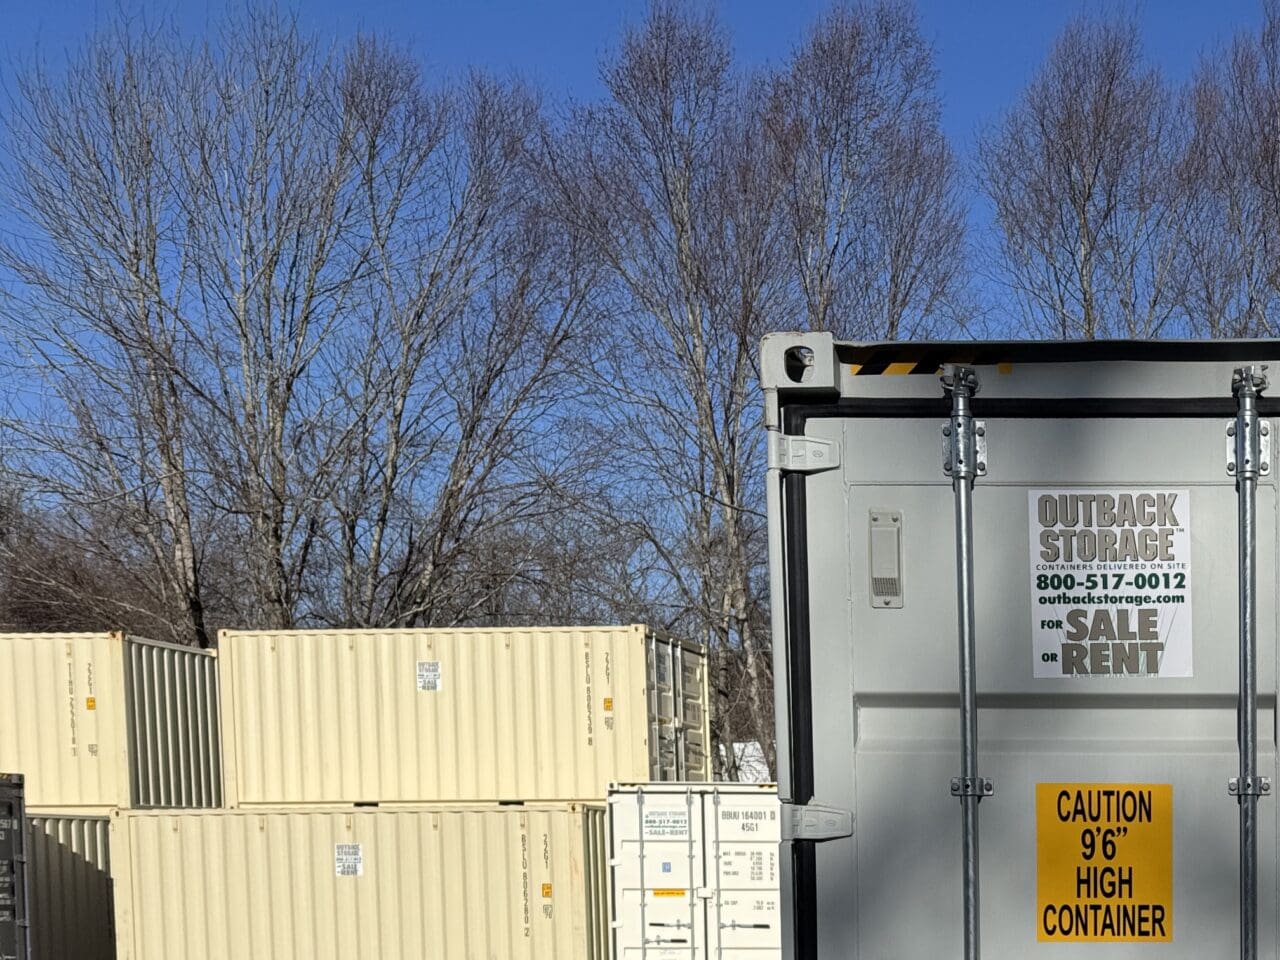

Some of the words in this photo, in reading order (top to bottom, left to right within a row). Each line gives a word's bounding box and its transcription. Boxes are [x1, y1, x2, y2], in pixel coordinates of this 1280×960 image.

[1038, 493, 1179, 527] OUTBACK
[1040, 528, 1174, 562] STORAGE
[1036, 572, 1186, 590] 800-517-0012
[1039, 592, 1185, 606] outbackstorage.com
[1041, 620, 1063, 629] FOR
[1066, 609, 1158, 641] SALE
[1042, 653, 1058, 662] OR
[1061, 642, 1164, 675] RENT
[1057, 790, 1151, 823] CAUTION
[741, 822, 758, 831] 45G1
[1076, 866, 1132, 899] HIGH
[1043, 904, 1166, 936] CONTAINER
